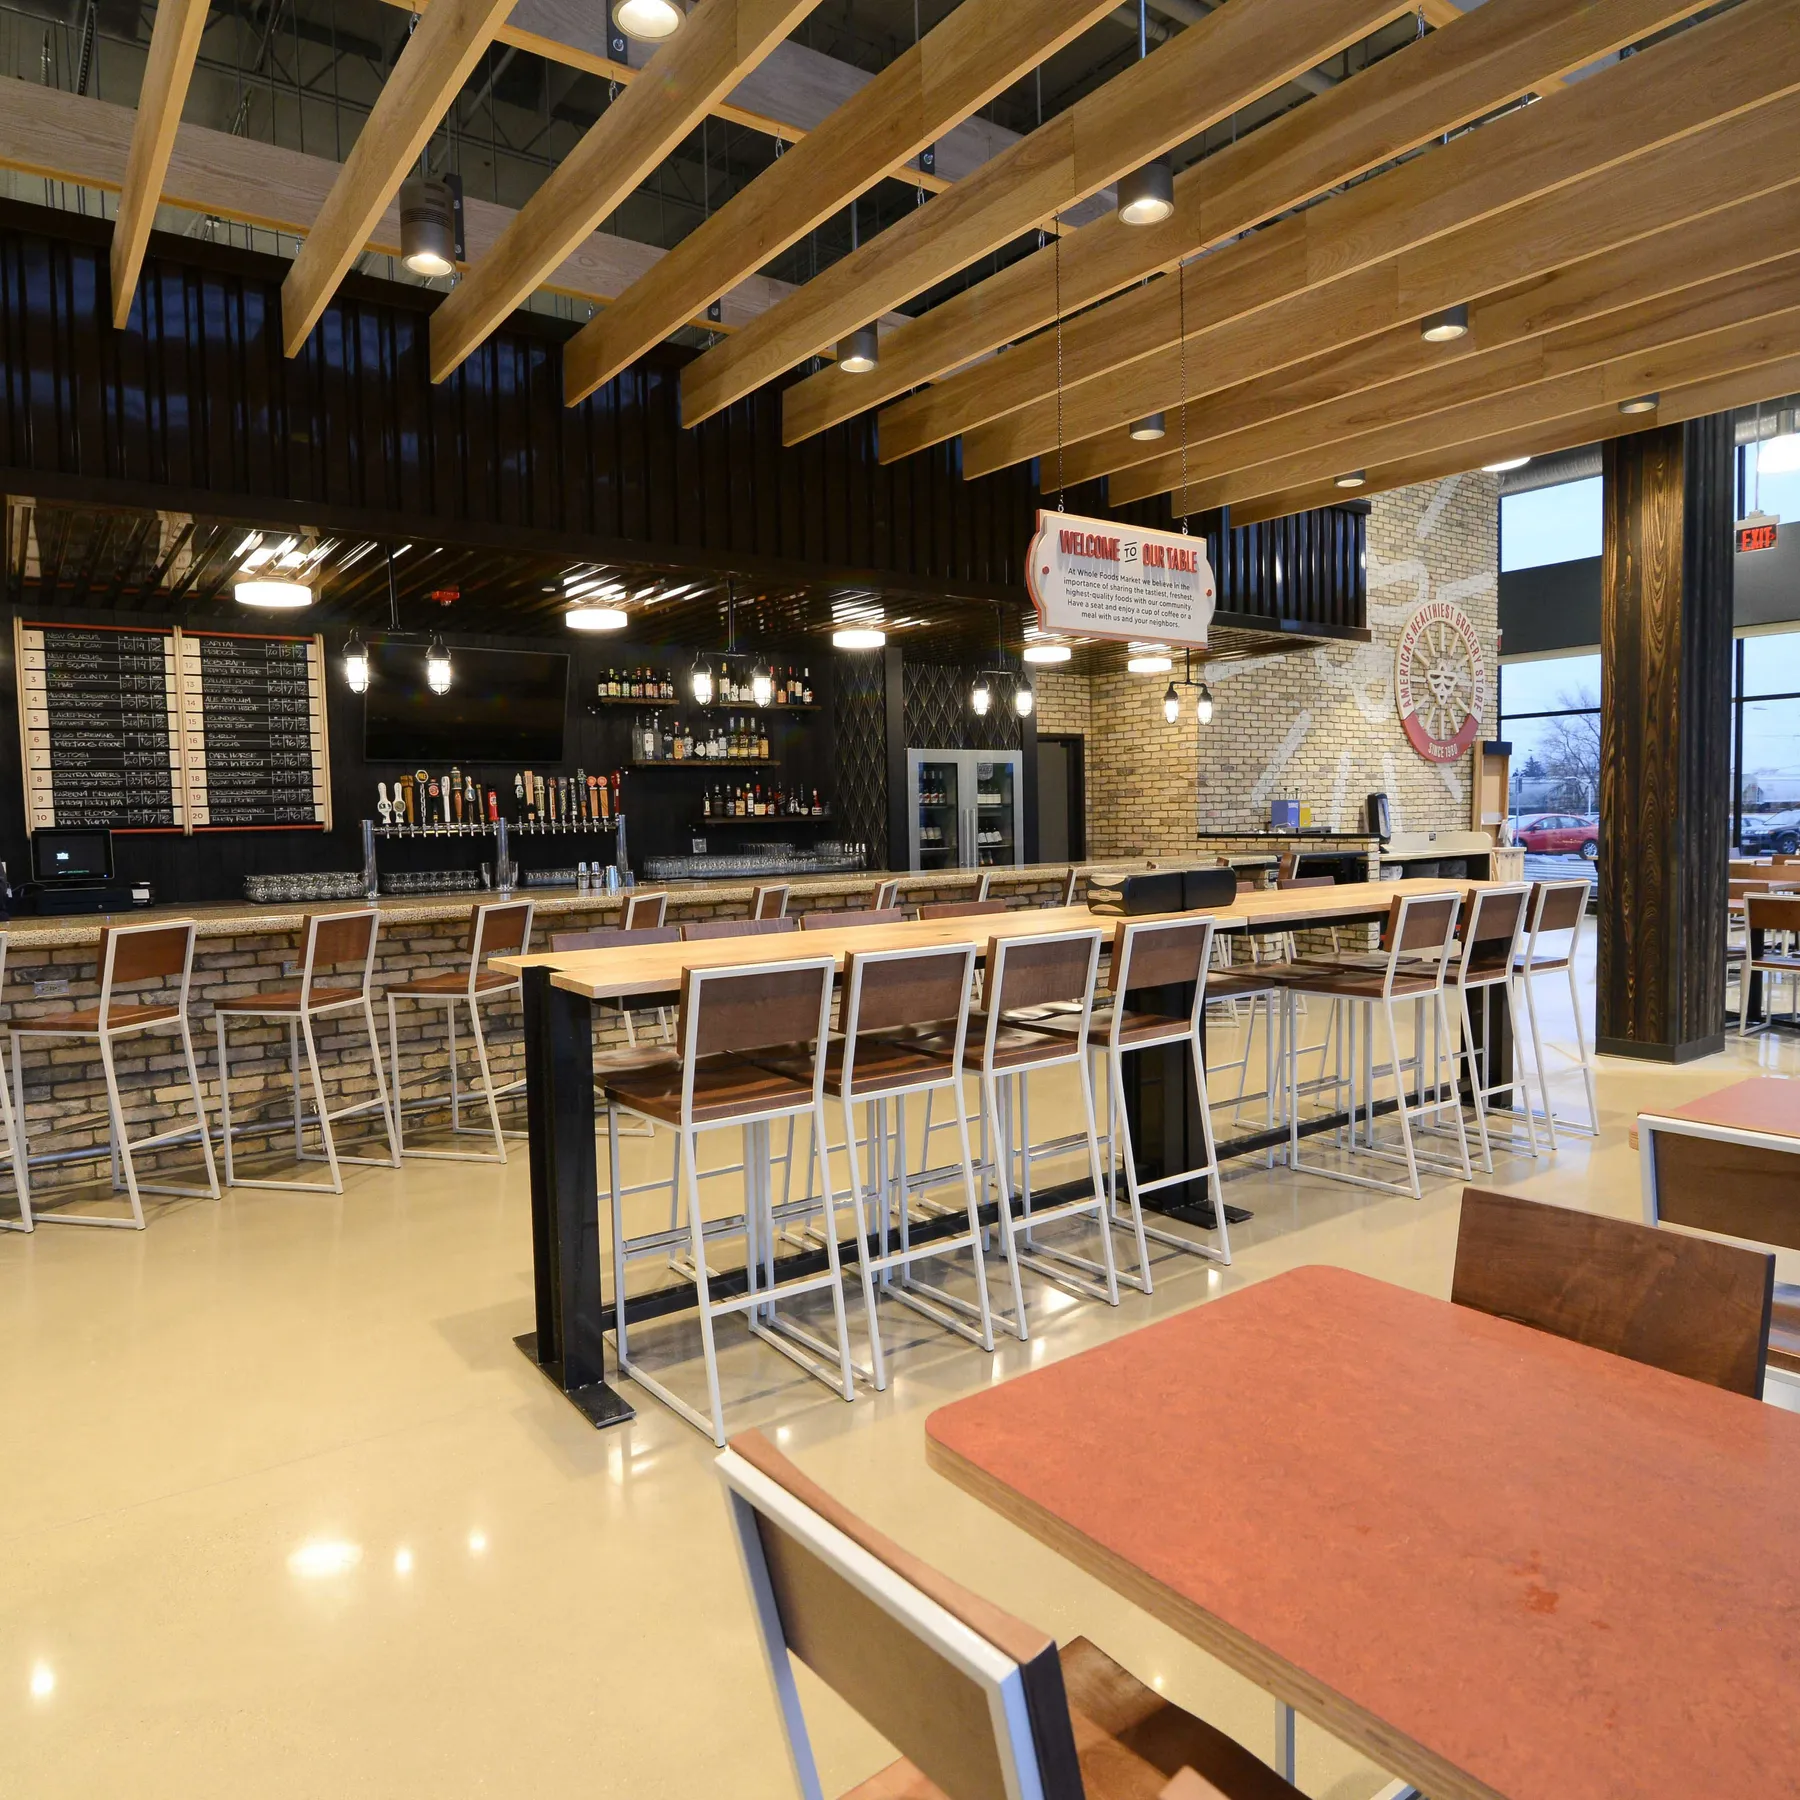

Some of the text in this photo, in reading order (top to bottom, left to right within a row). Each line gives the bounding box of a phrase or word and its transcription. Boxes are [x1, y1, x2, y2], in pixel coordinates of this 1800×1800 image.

[1742, 527, 1772, 551] EXIT
[1060, 530, 1197, 573] WELCOME TO OUR TABLE
[1078, 569, 1097, 578] Whole
[1100, 572, 1118, 581] Foods
[1120, 575, 1141, 584] Market
[1152, 579, 1172, 588] believe
[1064, 578, 1100, 590] importance
[1110, 584, 1133, 595] sharing
[1145, 589, 1168, 598] tastiest,
[1170, 591, 1194, 602] freshest,
[1066, 589, 1113, 602] highest-quality
[1115, 594, 1132, 602] foods
[1134, 596, 1146, 604] with
[1160, 600, 1192, 611] community.
[1068, 599, 1084, 608] Have
[1118, 606, 1134, 614] enjoy
[1161, 610, 1179, 618] coffee
[1082, 611, 1097, 619] meal
[1121, 614, 1132, 622] and
[1149, 618, 1179, 628] neighbors.
[1400, 603, 1484, 712] AMERICA'S HEALTHIEST GROCERY STORE
[1428, 742, 1444, 758] SINCE
